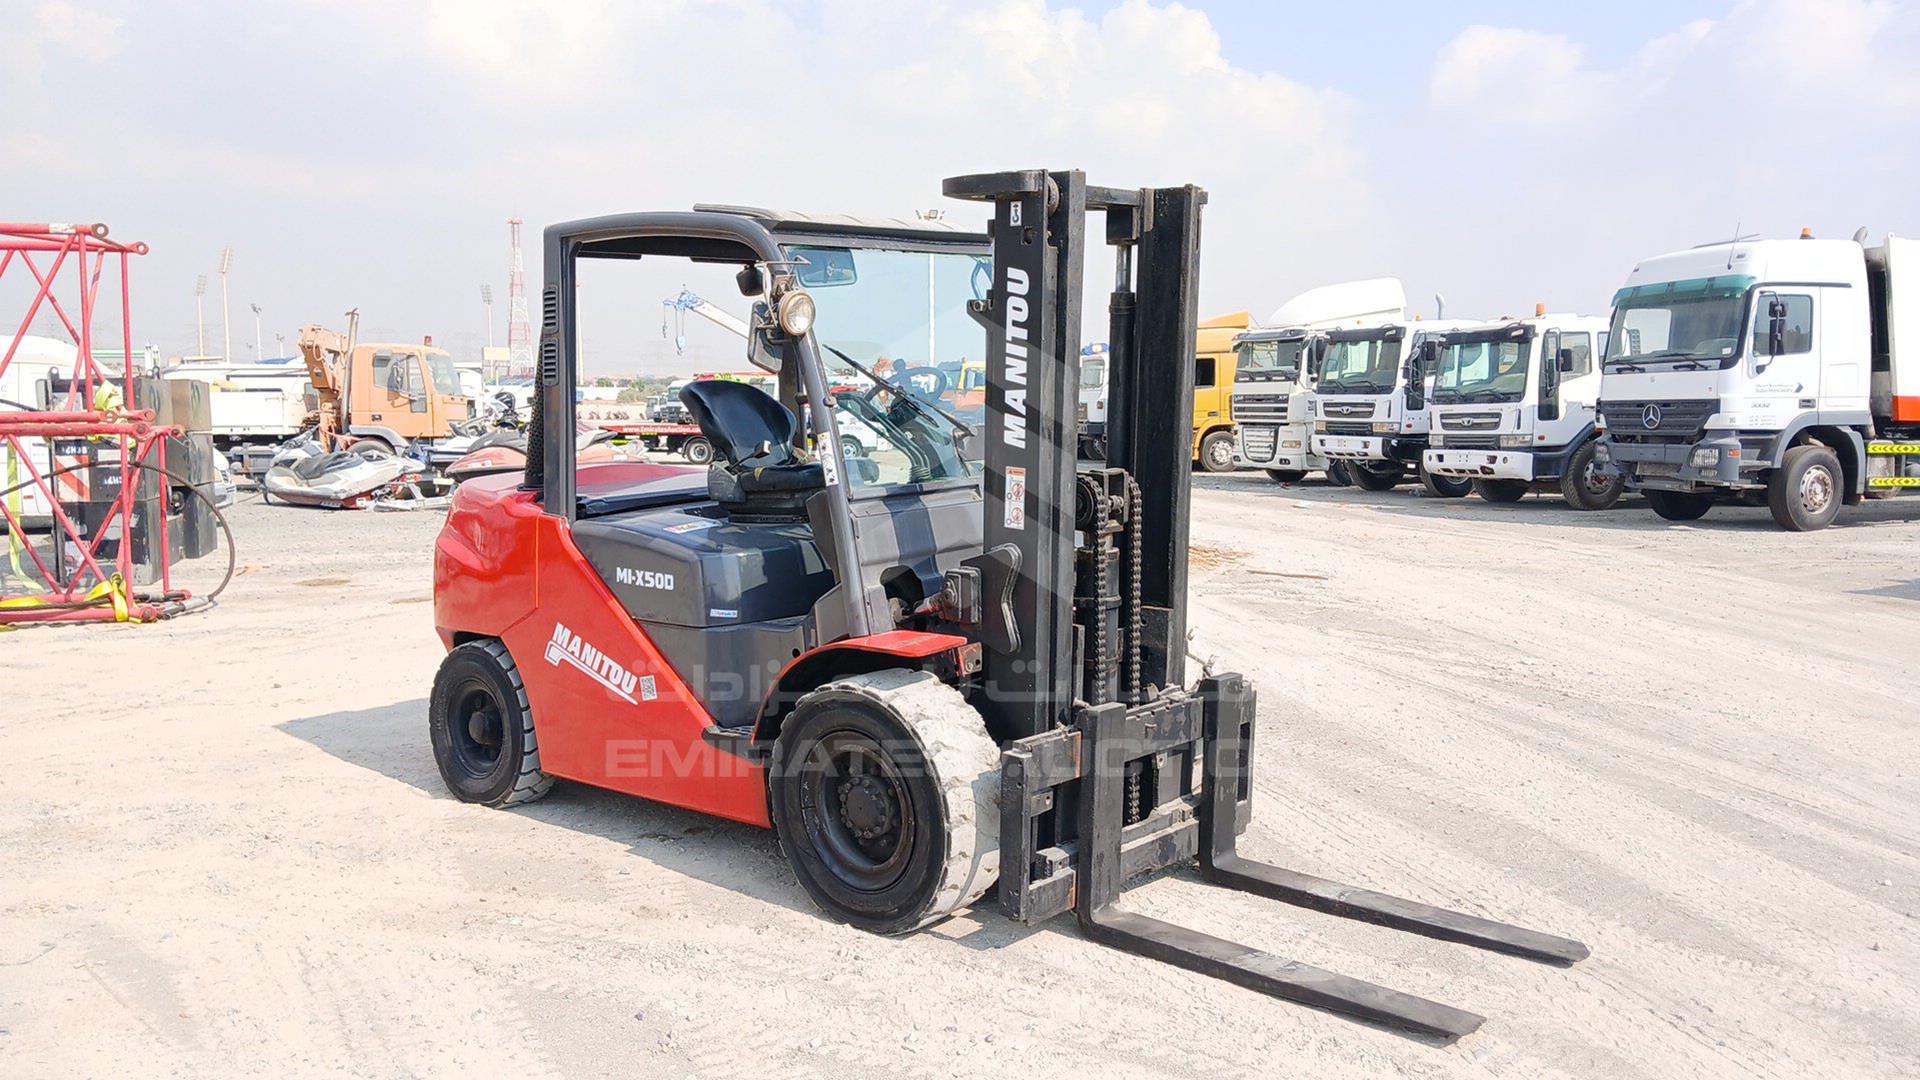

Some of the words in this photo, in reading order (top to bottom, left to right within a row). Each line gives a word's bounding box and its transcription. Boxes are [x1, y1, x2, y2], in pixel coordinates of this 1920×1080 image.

[1004, 266, 1030, 449] MANITOU
[616, 567, 674, 590] MI-X50D
[553, 622, 638, 693] MANITOU
